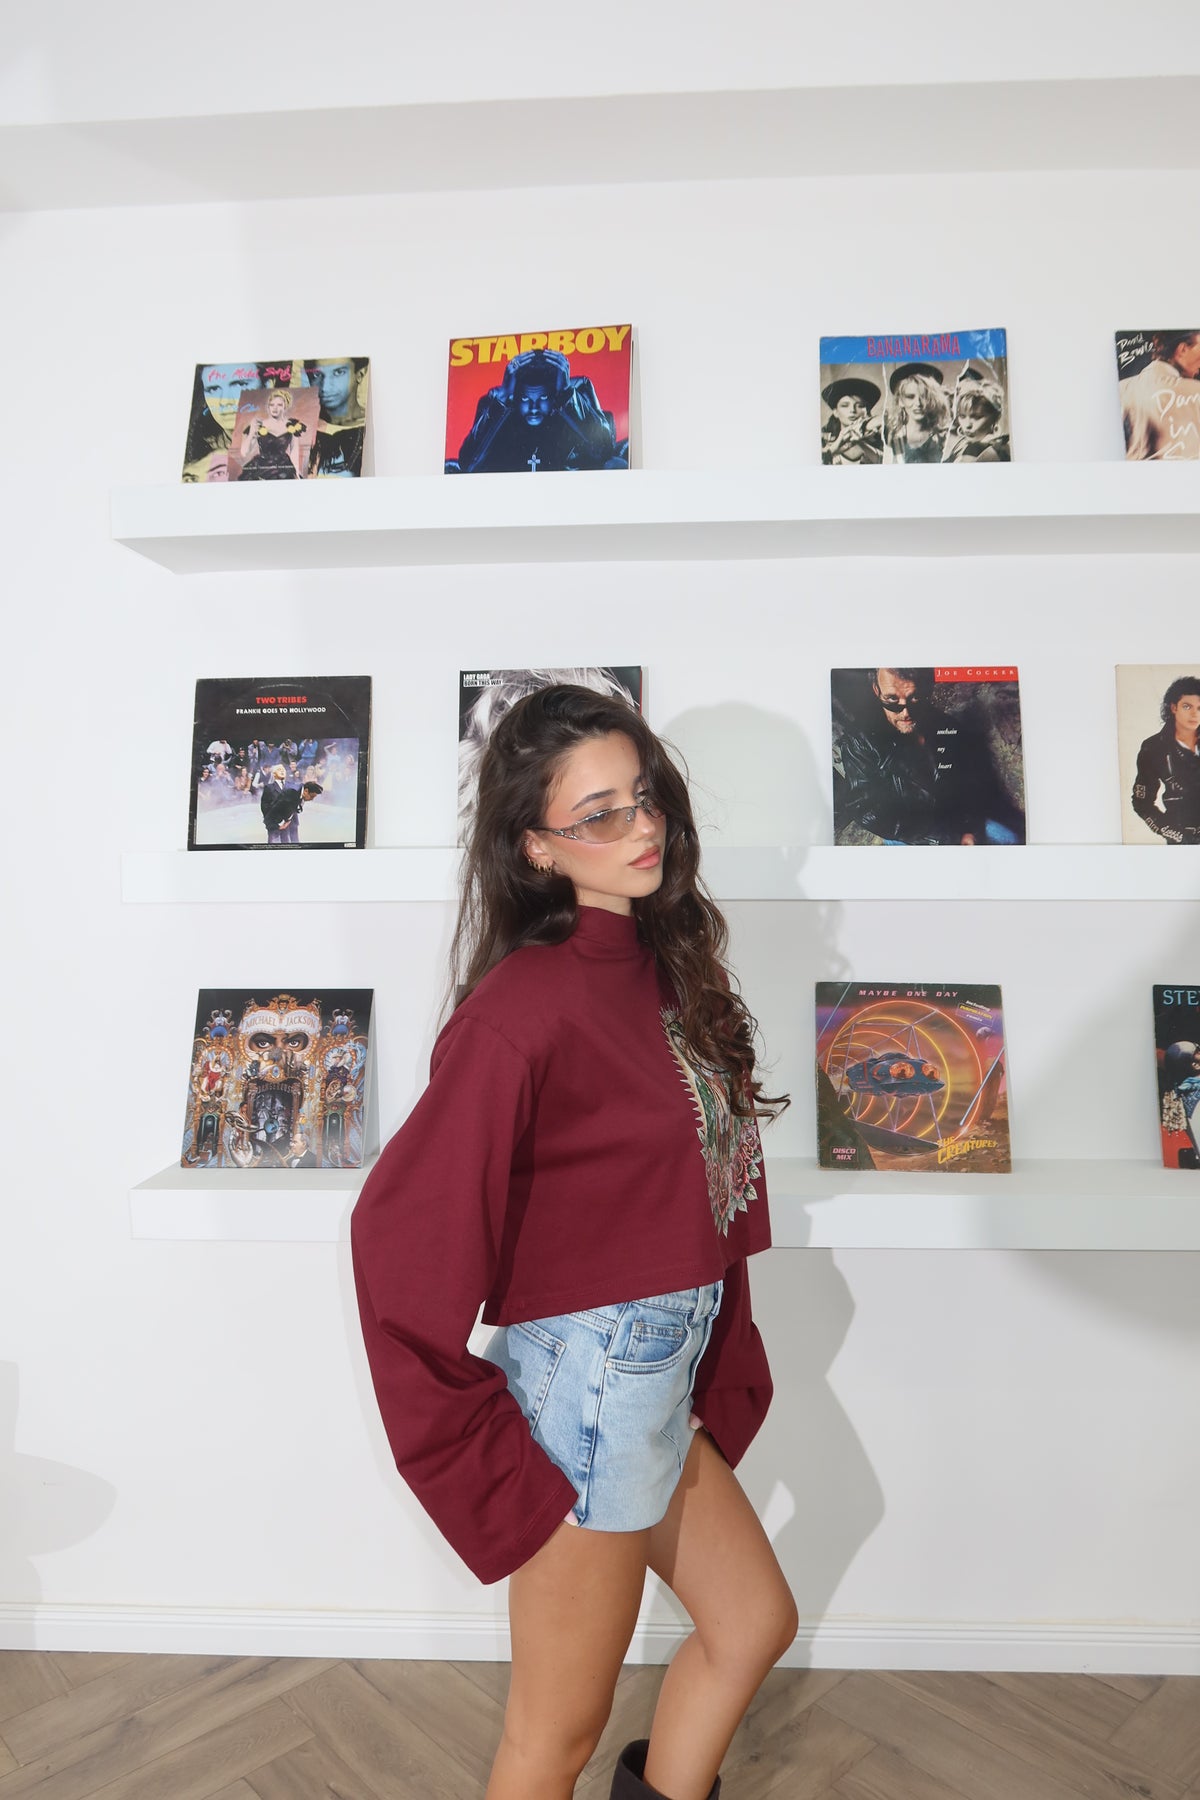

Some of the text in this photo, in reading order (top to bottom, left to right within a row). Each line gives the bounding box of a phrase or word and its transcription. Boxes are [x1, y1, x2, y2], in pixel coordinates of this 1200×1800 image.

[450, 326, 631, 367] STARBOY
[867, 333, 960, 359] BANANARAMA
[464, 679, 478, 687] BORN
[255, 696, 307, 704] TWO TRIBES
[1163, 989, 1200, 1006] STE
[245, 1014, 316, 1029] MICHAEL JACKSON
